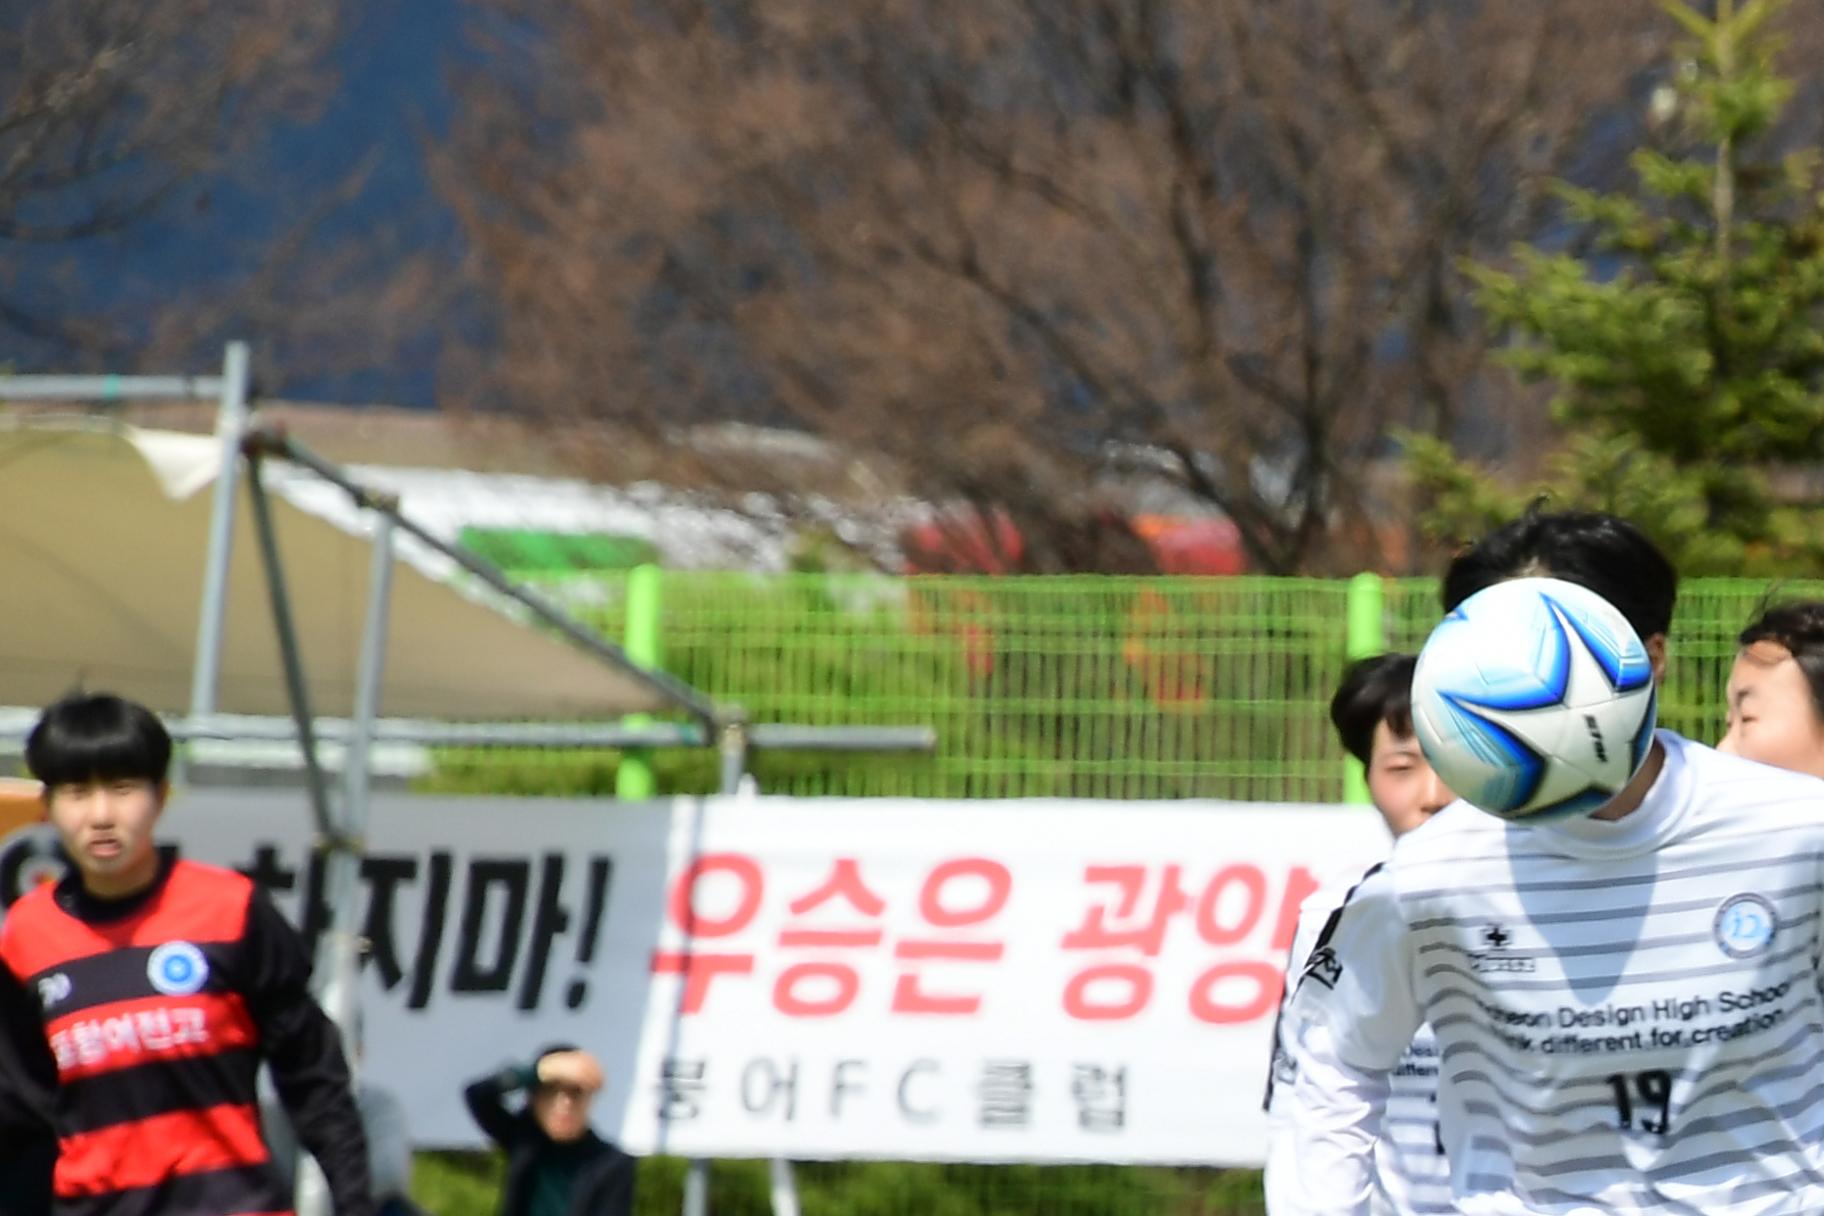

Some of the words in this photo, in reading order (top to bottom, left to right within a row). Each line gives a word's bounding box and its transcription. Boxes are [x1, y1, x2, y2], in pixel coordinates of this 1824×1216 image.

[652, 853, 1013, 1018] 우승은
[1557, 1004, 1645, 1028] Design
[1653, 994, 1711, 1021] High
[1651, 1026, 1684, 1046] for
[1605, 1068, 1672, 1136] 19
